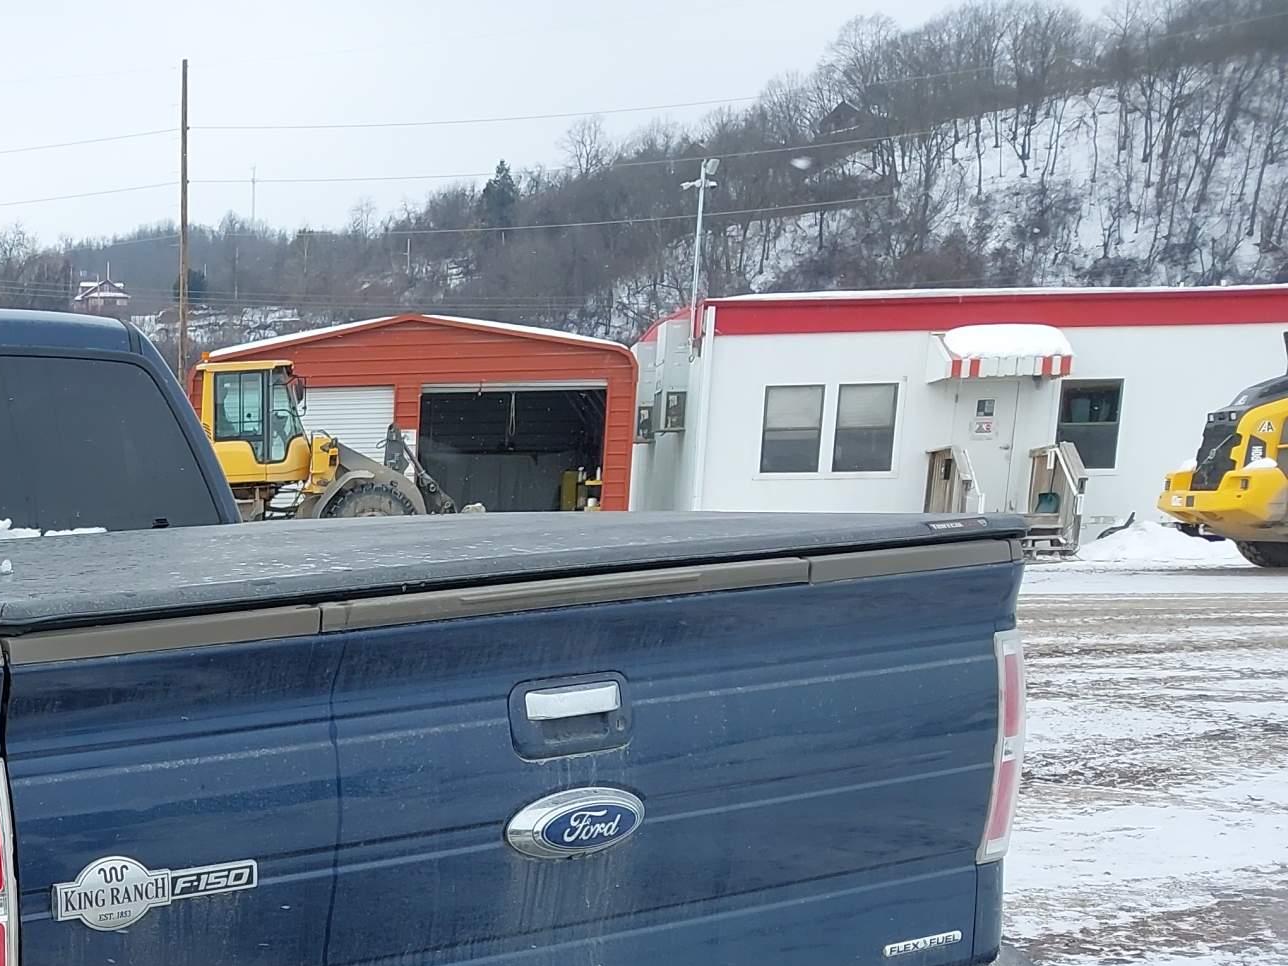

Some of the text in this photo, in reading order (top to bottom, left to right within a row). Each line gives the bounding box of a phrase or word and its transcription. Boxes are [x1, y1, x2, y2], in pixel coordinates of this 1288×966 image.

[563, 809, 621, 843] Ford
[63, 877, 167, 913] KING RANCH
[174, 867, 250, 894] F-150
[889, 934, 960, 955] FLEX FUEL
